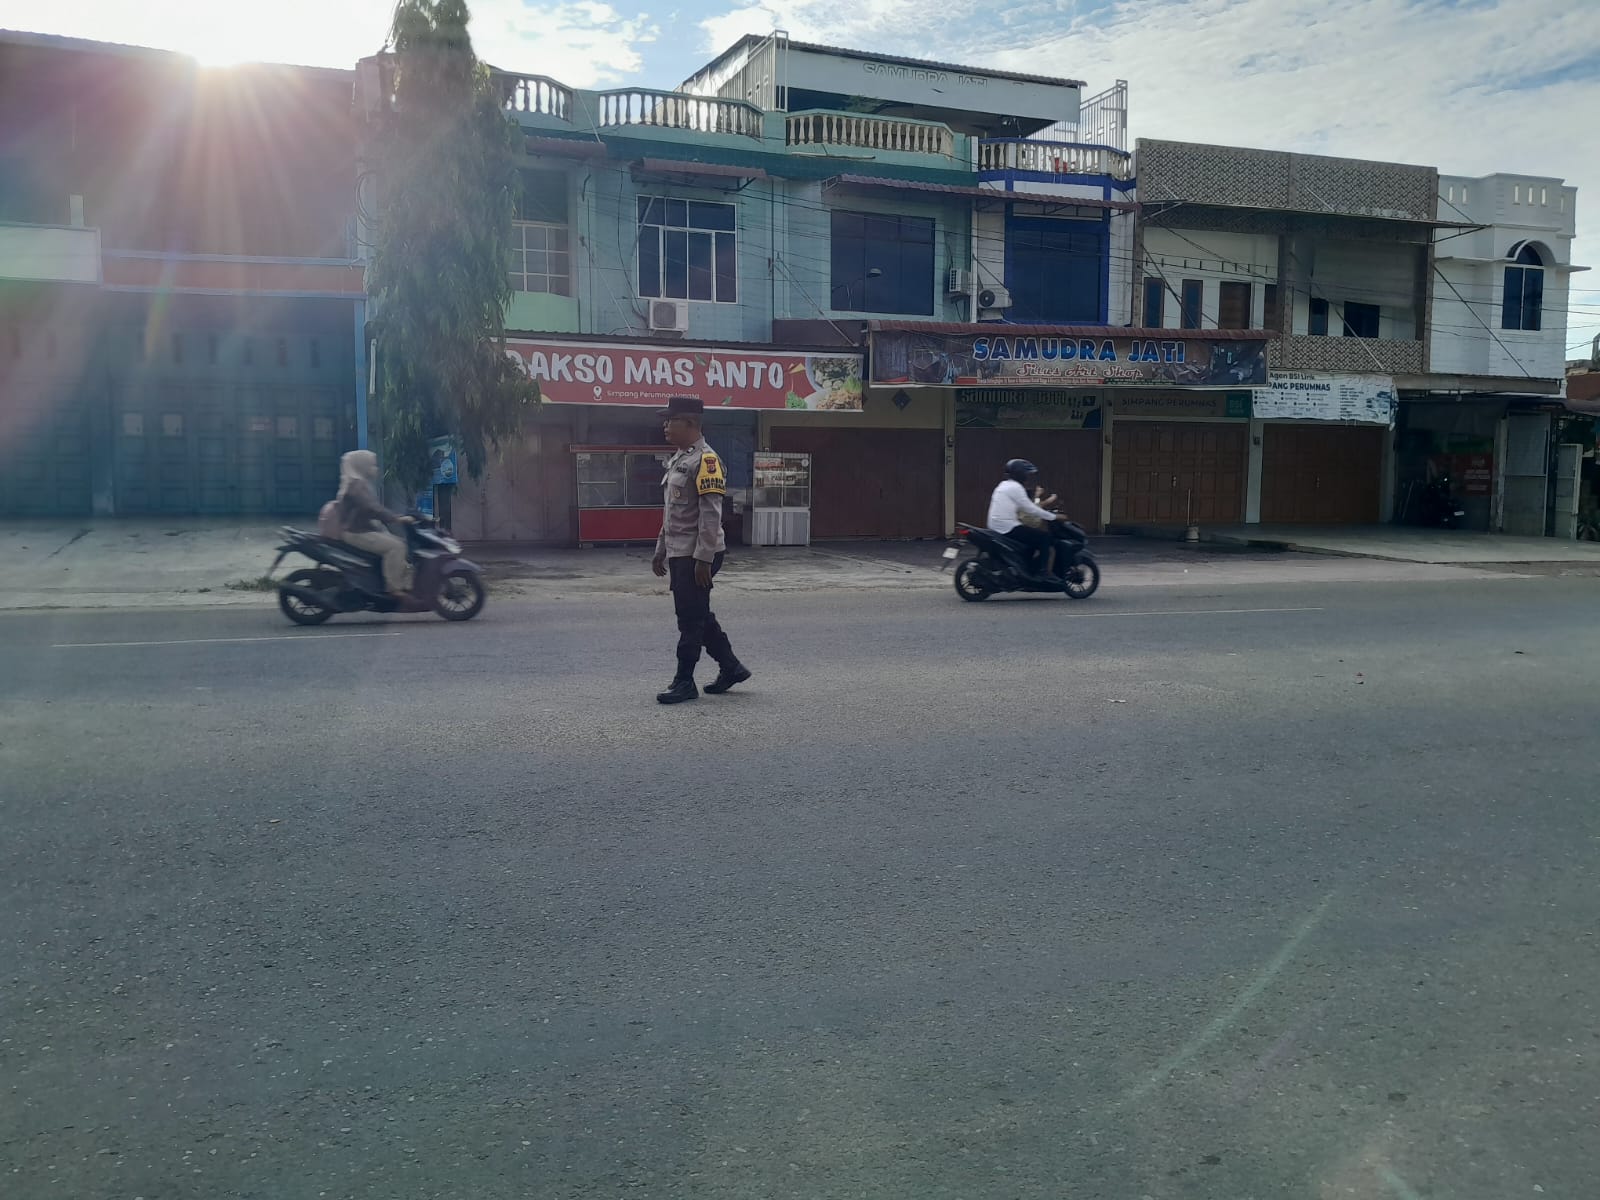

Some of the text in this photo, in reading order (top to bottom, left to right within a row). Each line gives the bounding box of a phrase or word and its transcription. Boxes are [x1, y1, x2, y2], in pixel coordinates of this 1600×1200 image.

[973, 337, 1186, 363] SAMUDRA JATI
[624, 356, 694, 387] MAS
[705, 358, 784, 389] ANTO
[1103, 365, 1144, 380] Shop
[1269, 372, 1288, 380] Agen
[1289, 382, 1331, 391] PERUMNAS
[1121, 397, 1217, 408] SIMPANG PERUMNAS
